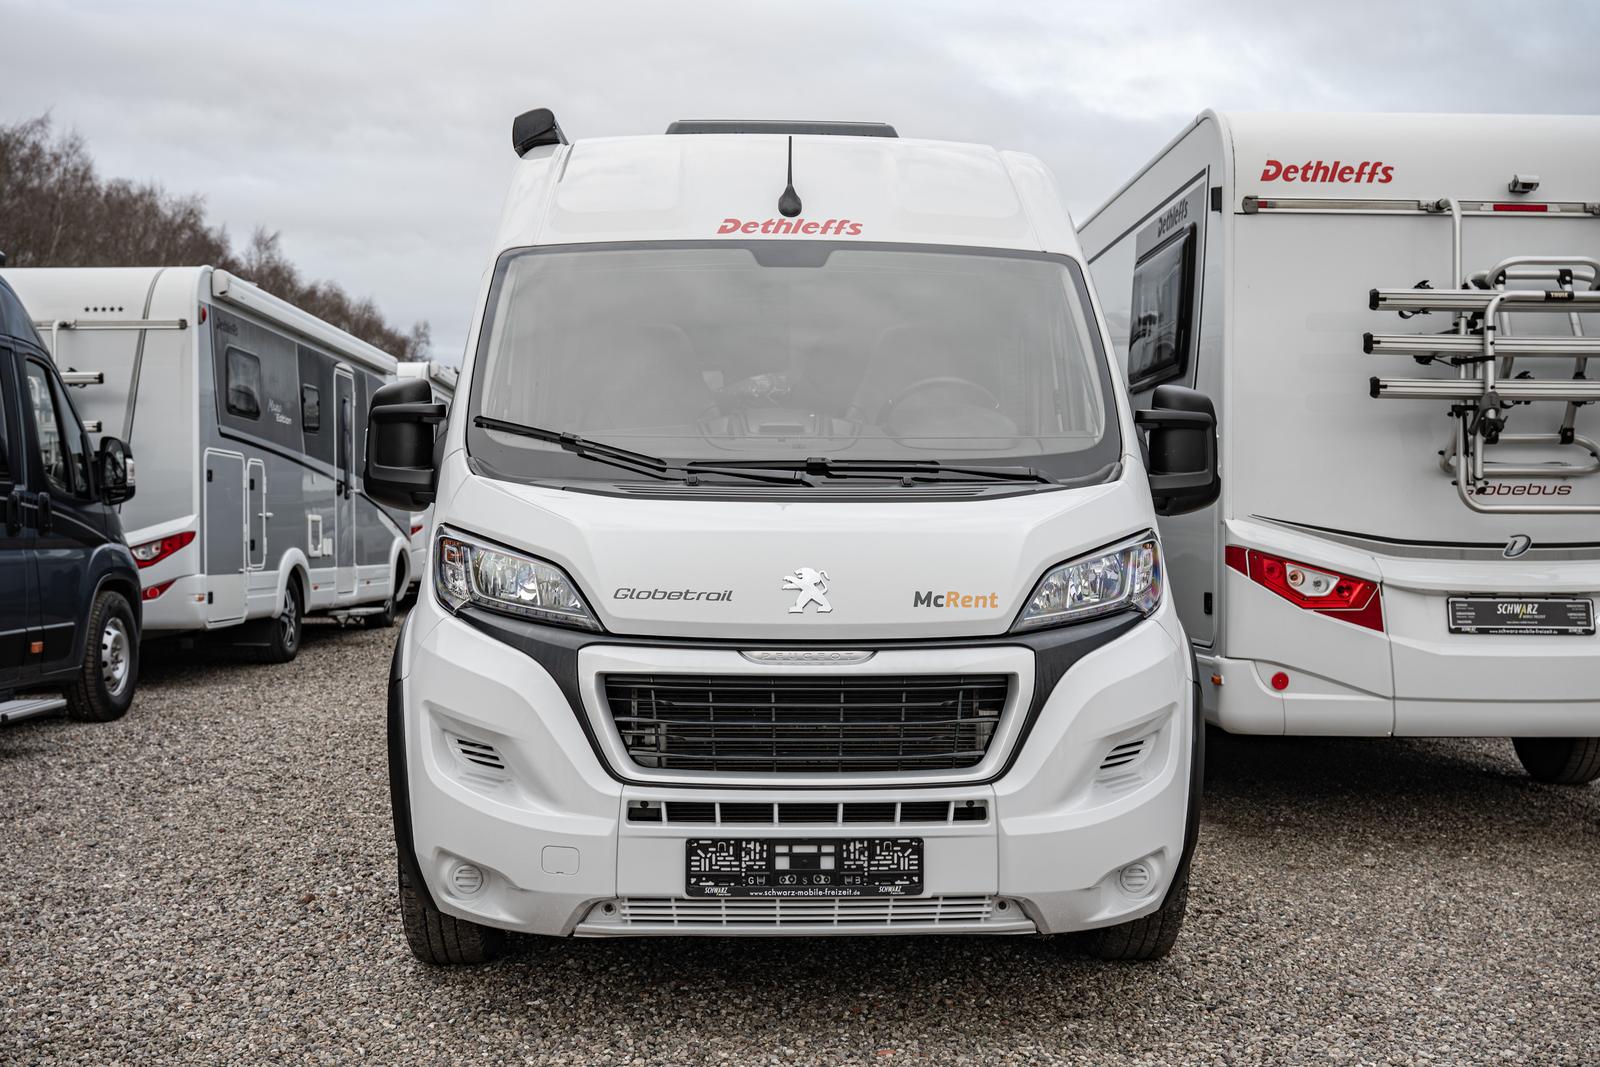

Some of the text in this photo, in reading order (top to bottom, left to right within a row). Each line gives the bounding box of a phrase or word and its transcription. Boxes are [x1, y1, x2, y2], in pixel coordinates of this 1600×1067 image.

[1260, 159, 1394, 184] Dethleffs
[1157, 198, 1189, 238] Dethleffs
[717, 217, 863, 236] Dethleffs
[1466, 483, 1573, 496] obebus
[613, 587, 734, 602] Globetrail
[913, 590, 999, 609] McRent
[1496, 603, 1539, 619] SCHWARZ
[760, 652, 854, 661] PEUGEOT
[704, 886, 729, 895] SCHWARZ
[749, 888, 861, 896] www.schwarz-mobile-freizeit.de
